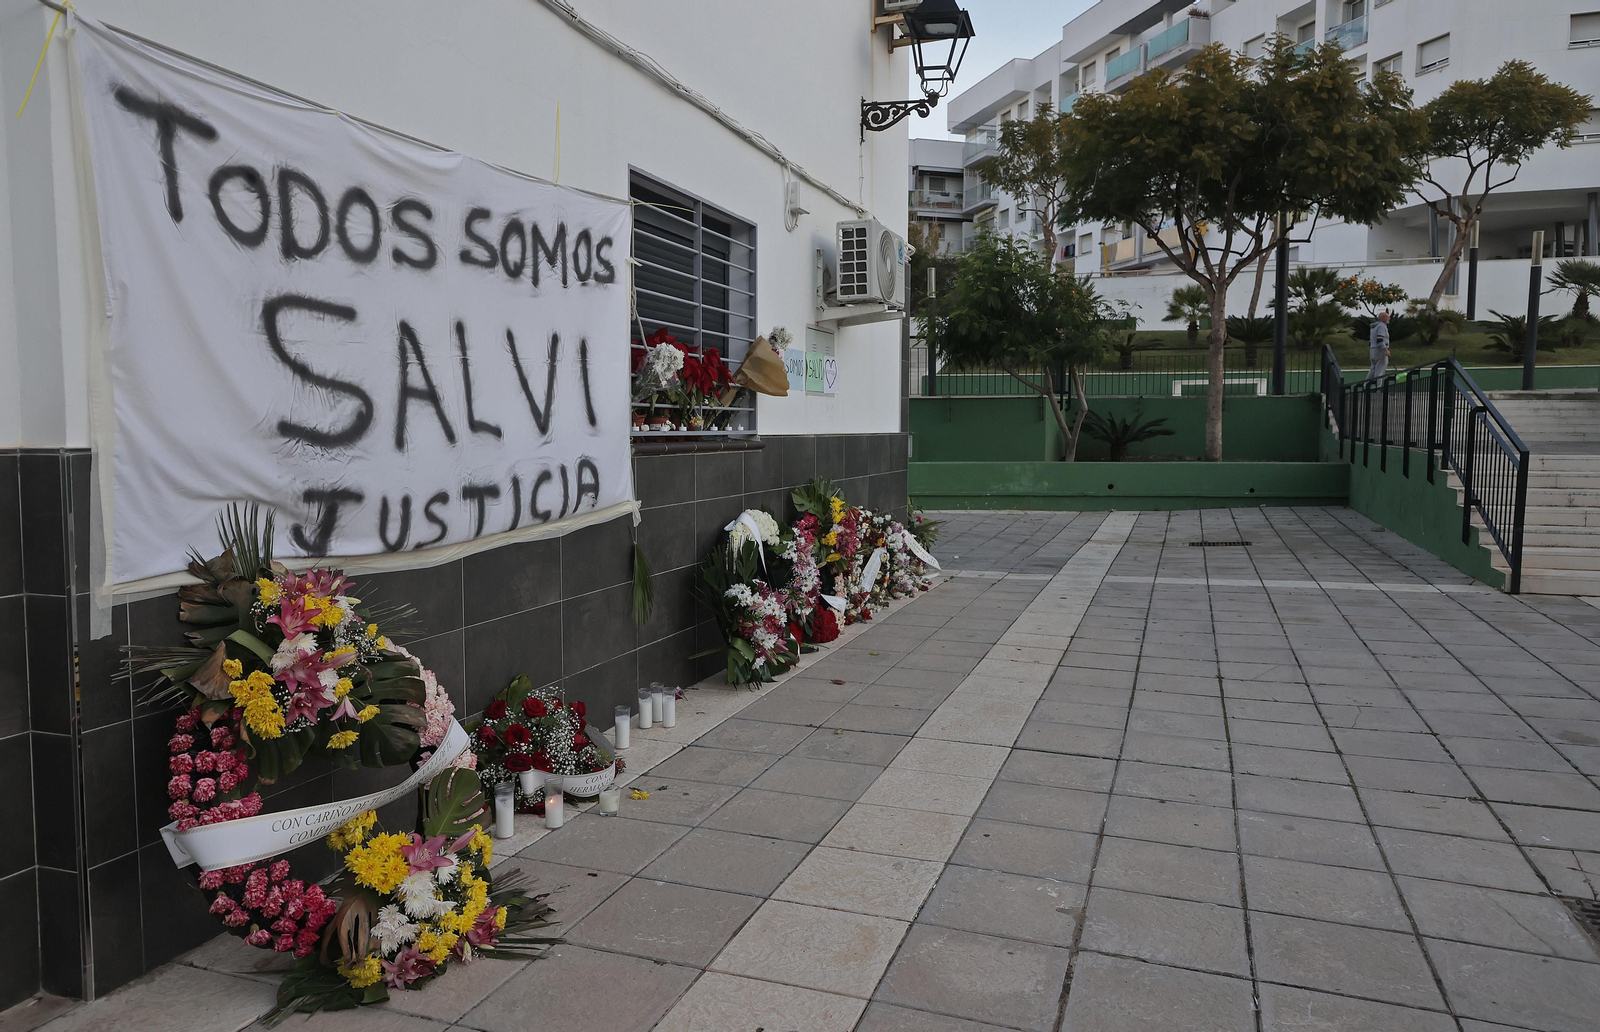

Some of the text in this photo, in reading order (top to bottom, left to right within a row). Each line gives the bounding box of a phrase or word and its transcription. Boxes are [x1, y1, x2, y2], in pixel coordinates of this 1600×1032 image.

[113, 86, 615, 287] TODOS SOMOS
[261, 294, 597, 451] SALVI
[292, 459, 600, 556] JUSTICIA
[271, 816, 303, 833] CON
[305, 805, 351, 826] CARIÑO
